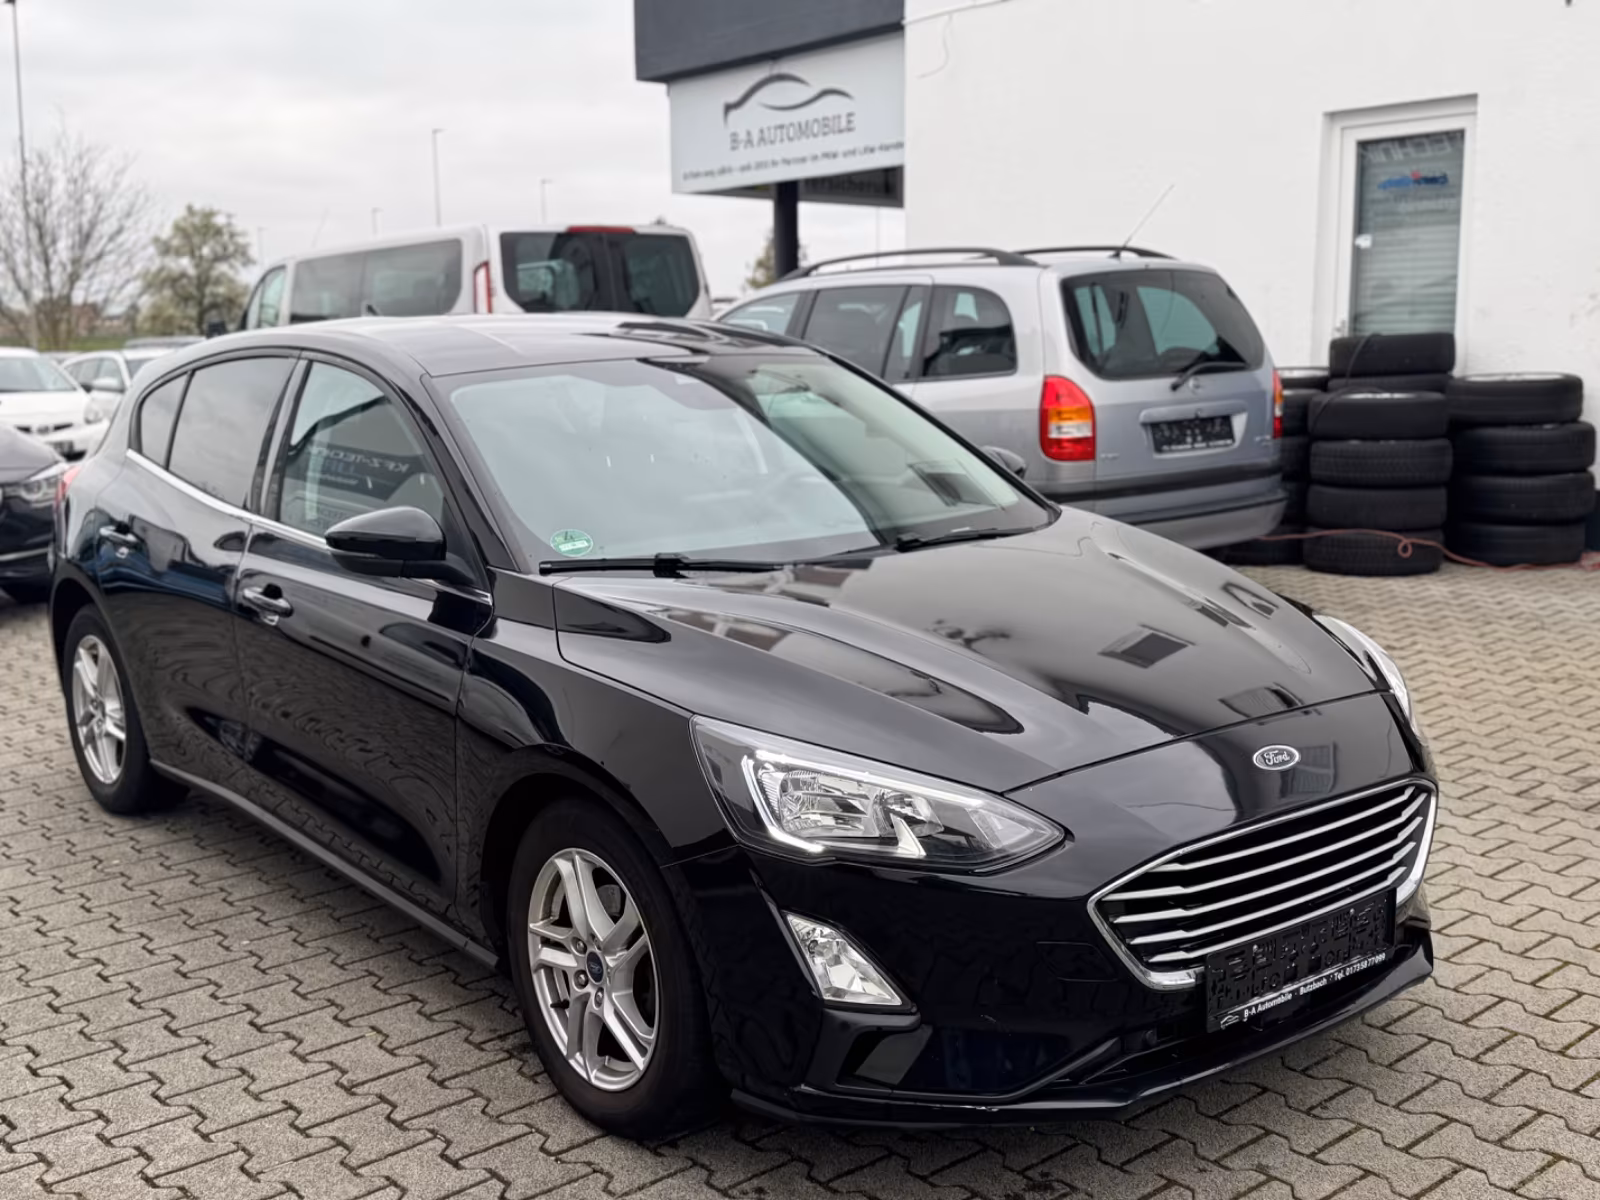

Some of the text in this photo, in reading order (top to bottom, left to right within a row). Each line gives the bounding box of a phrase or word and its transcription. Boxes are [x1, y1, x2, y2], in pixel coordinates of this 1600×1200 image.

[730, 112, 856, 152] B-A AUTOMOBILE
[1264, 750, 1290, 765] Ford
[1244, 1006, 1257, 1018] B-A
[1257, 993, 1292, 1013] Automobile
[1299, 977, 1328, 996] Butzbach
